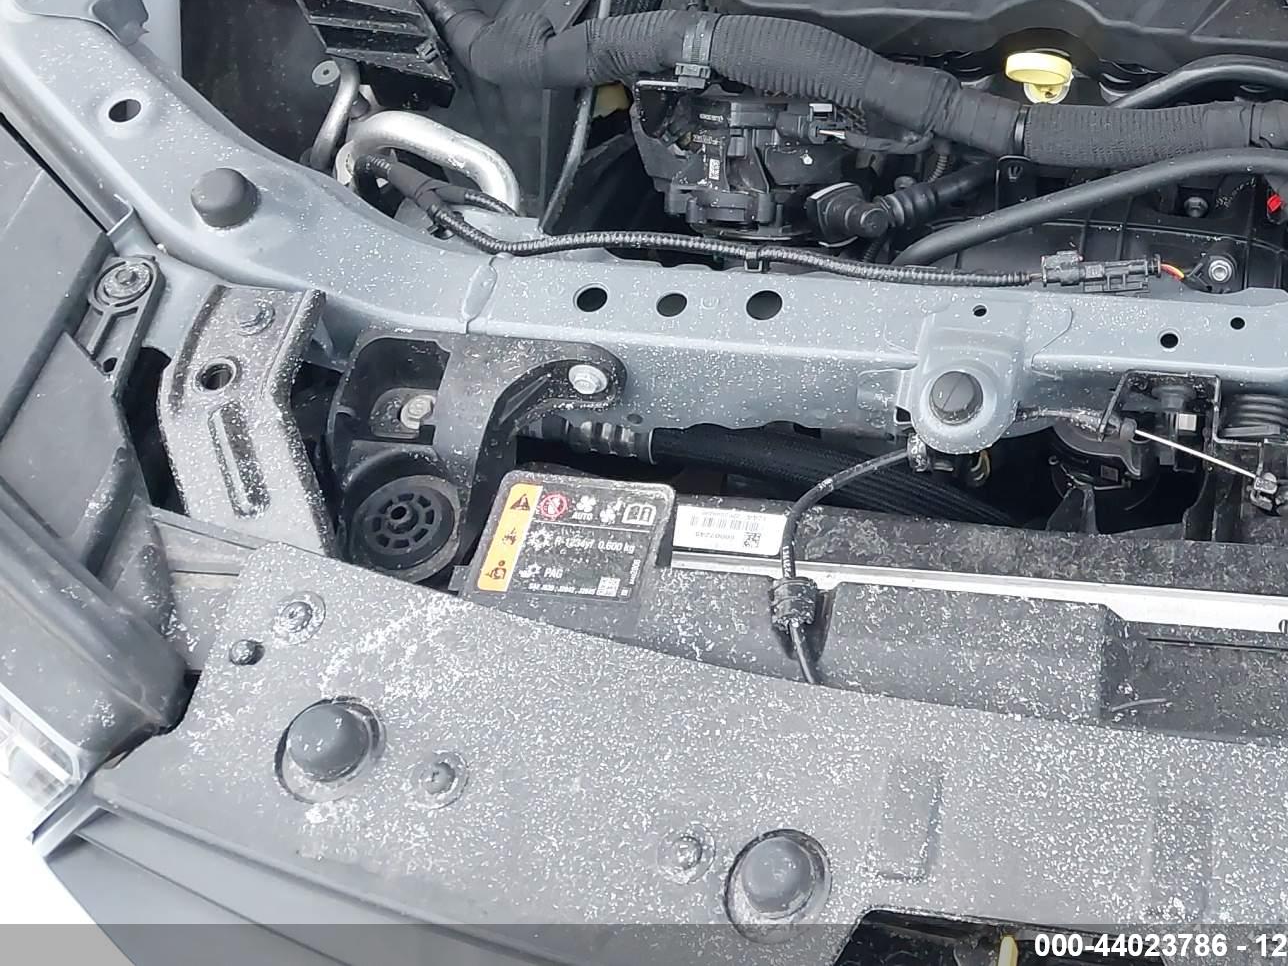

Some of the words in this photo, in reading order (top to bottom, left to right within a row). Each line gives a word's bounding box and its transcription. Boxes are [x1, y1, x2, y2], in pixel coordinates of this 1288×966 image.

[571, 511, 594, 521] AUTO
[623, 542, 635, 555] kg
[543, 567, 563, 579] PAG
